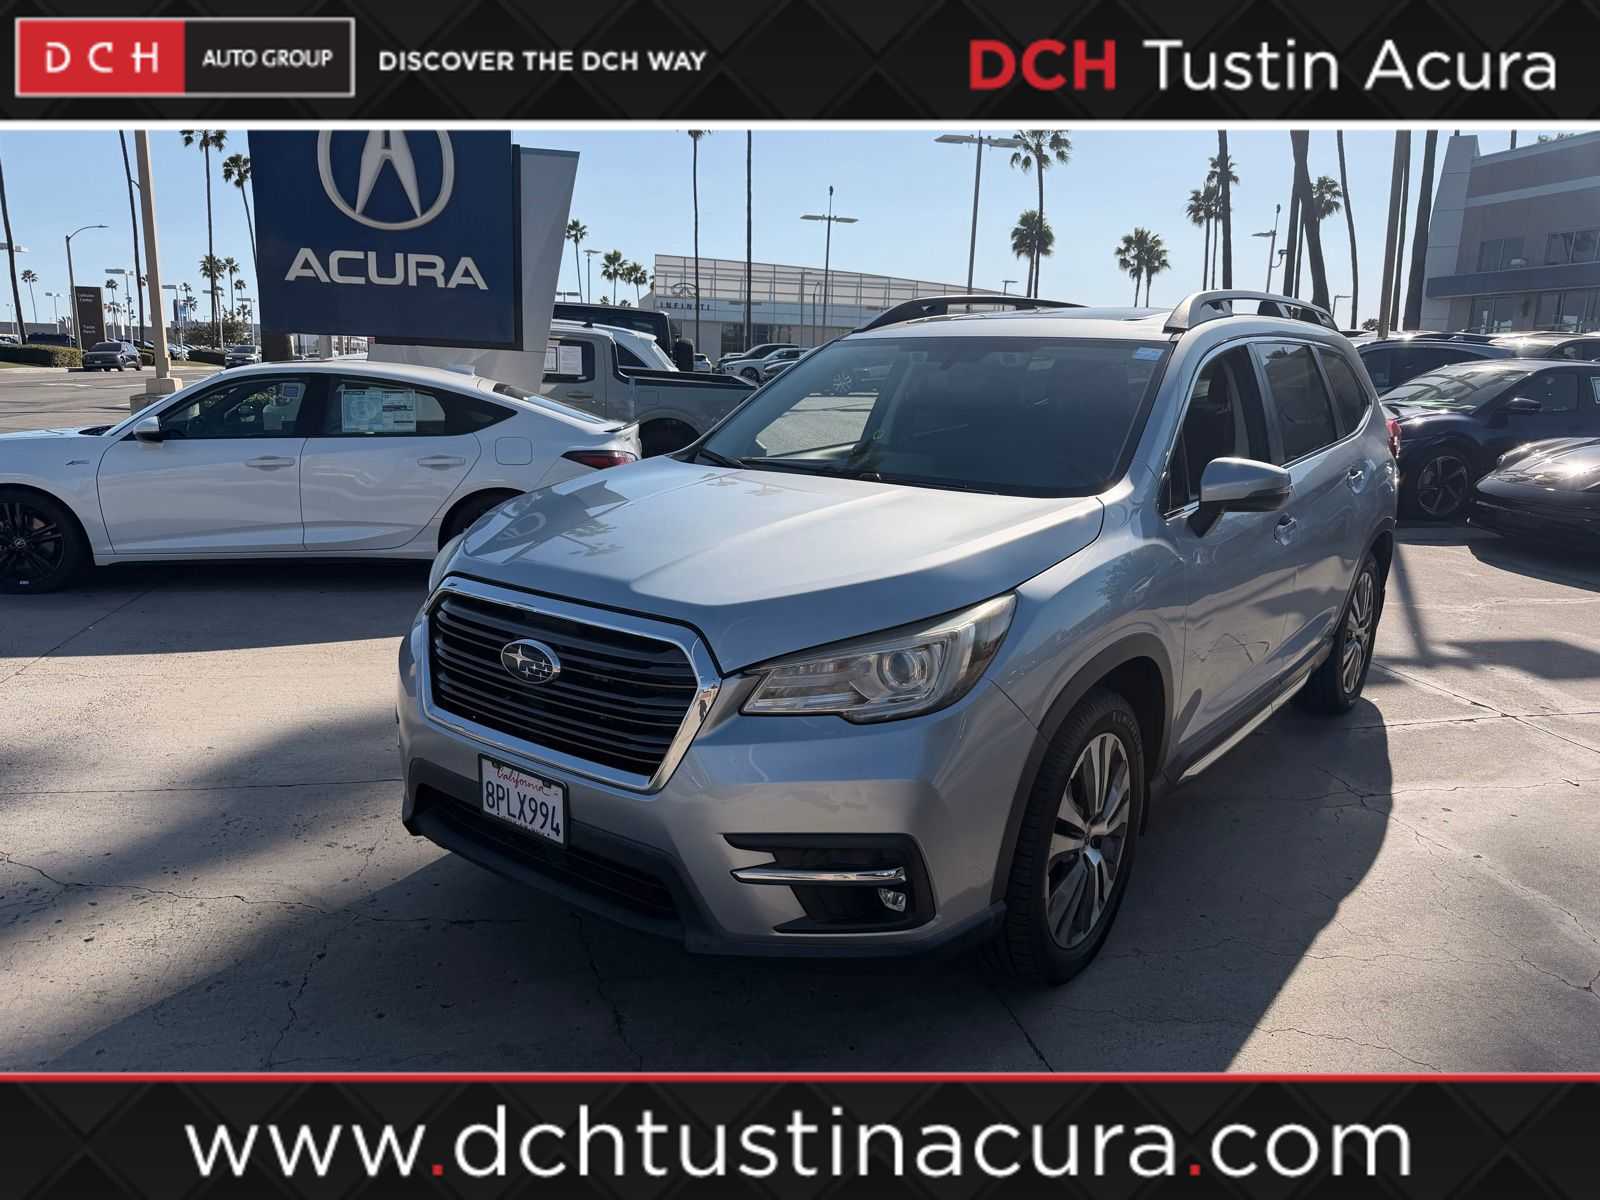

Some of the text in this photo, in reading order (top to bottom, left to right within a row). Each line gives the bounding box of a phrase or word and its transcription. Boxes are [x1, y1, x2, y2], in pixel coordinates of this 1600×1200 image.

[284, 247, 489, 290] ACURA
[659, 301, 710, 311] INFINTI
[495, 767, 550, 796] California
[485, 780, 561, 837] 8PLX994
